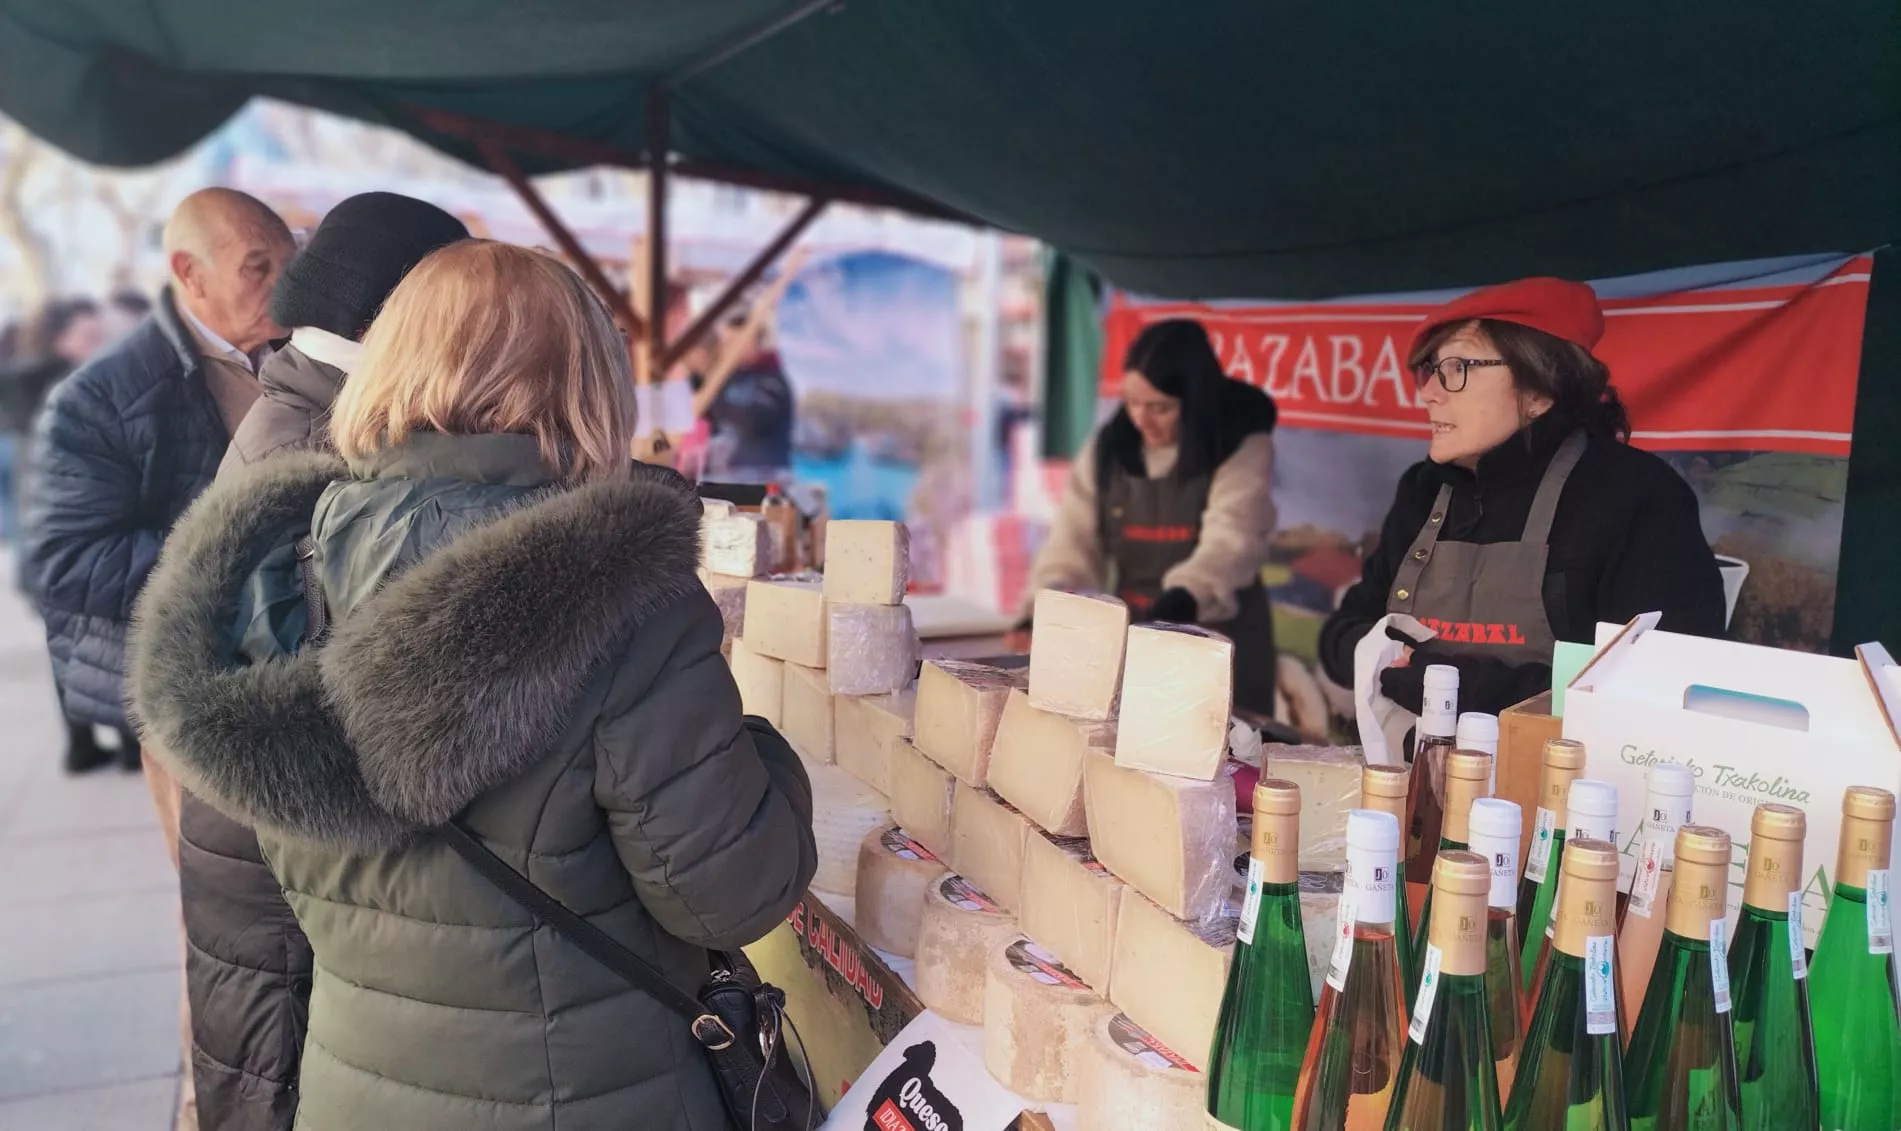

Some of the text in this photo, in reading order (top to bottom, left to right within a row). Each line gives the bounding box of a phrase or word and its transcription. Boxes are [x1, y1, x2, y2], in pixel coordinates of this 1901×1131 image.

[1213, 331, 1429, 409] AZABA
[1712, 764, 1810, 803] Txakolina
[1374, 866, 1390, 881] JO
[899, 1077, 949, 1131] Queso
